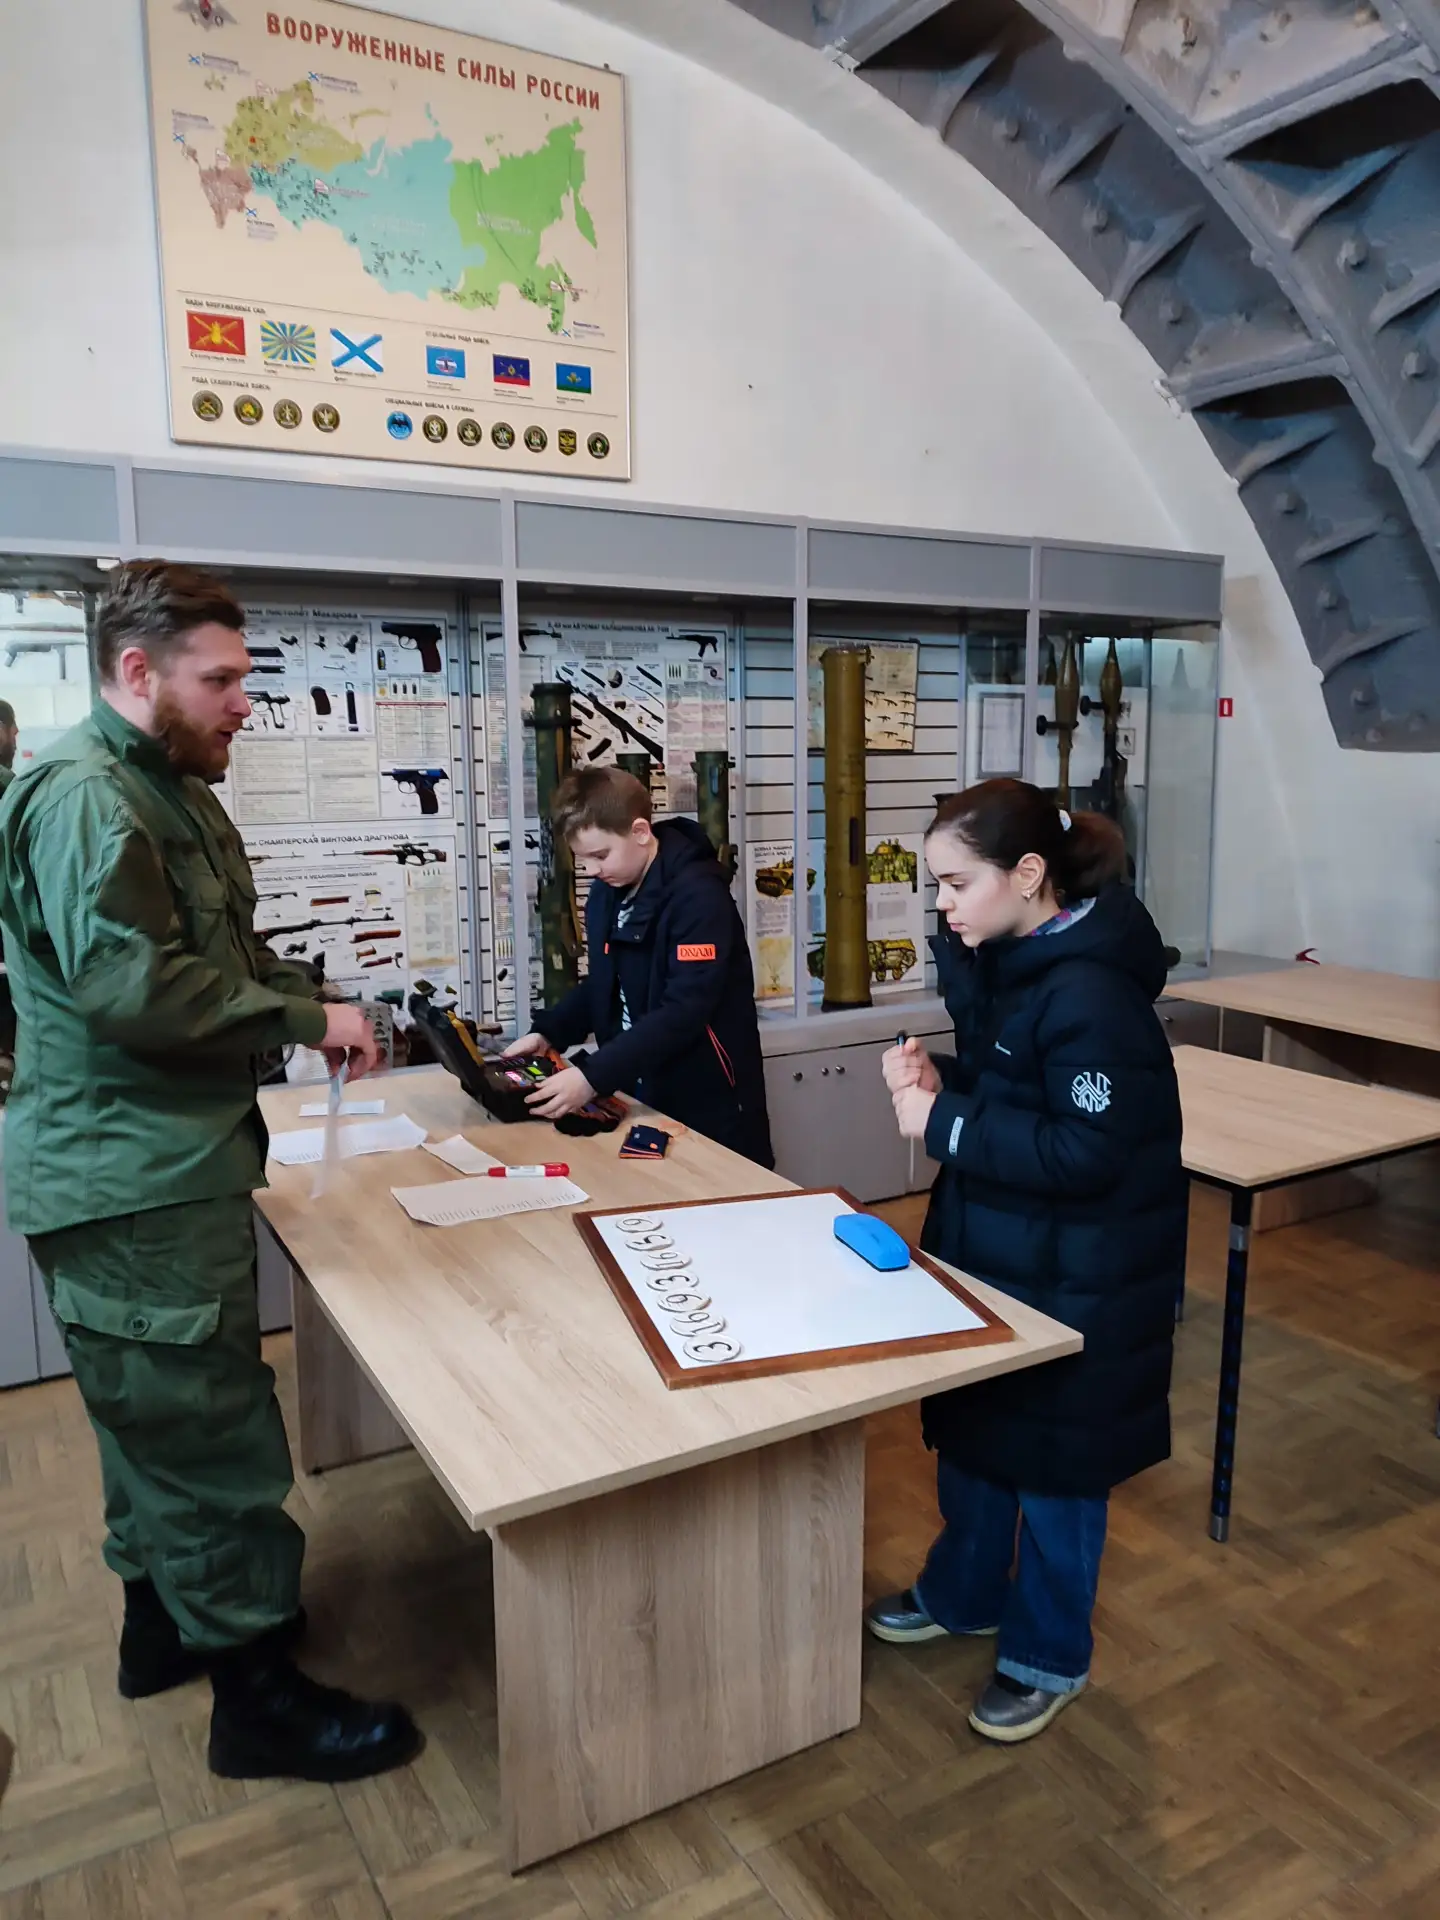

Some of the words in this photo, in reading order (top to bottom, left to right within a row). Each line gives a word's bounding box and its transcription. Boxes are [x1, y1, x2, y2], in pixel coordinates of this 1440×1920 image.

[266, 11, 446, 74] ВООРУЖЕННЫЕ
[457, 57, 516, 90] СИЛЫ
[526, 74, 600, 110] РОССИИ
[258, 836, 319, 847] СНАЙПЕРСКАЯ
[321, 834, 362, 844] ВИНТОВКА
[364, 833, 409, 843] ДРАГУНОВА
